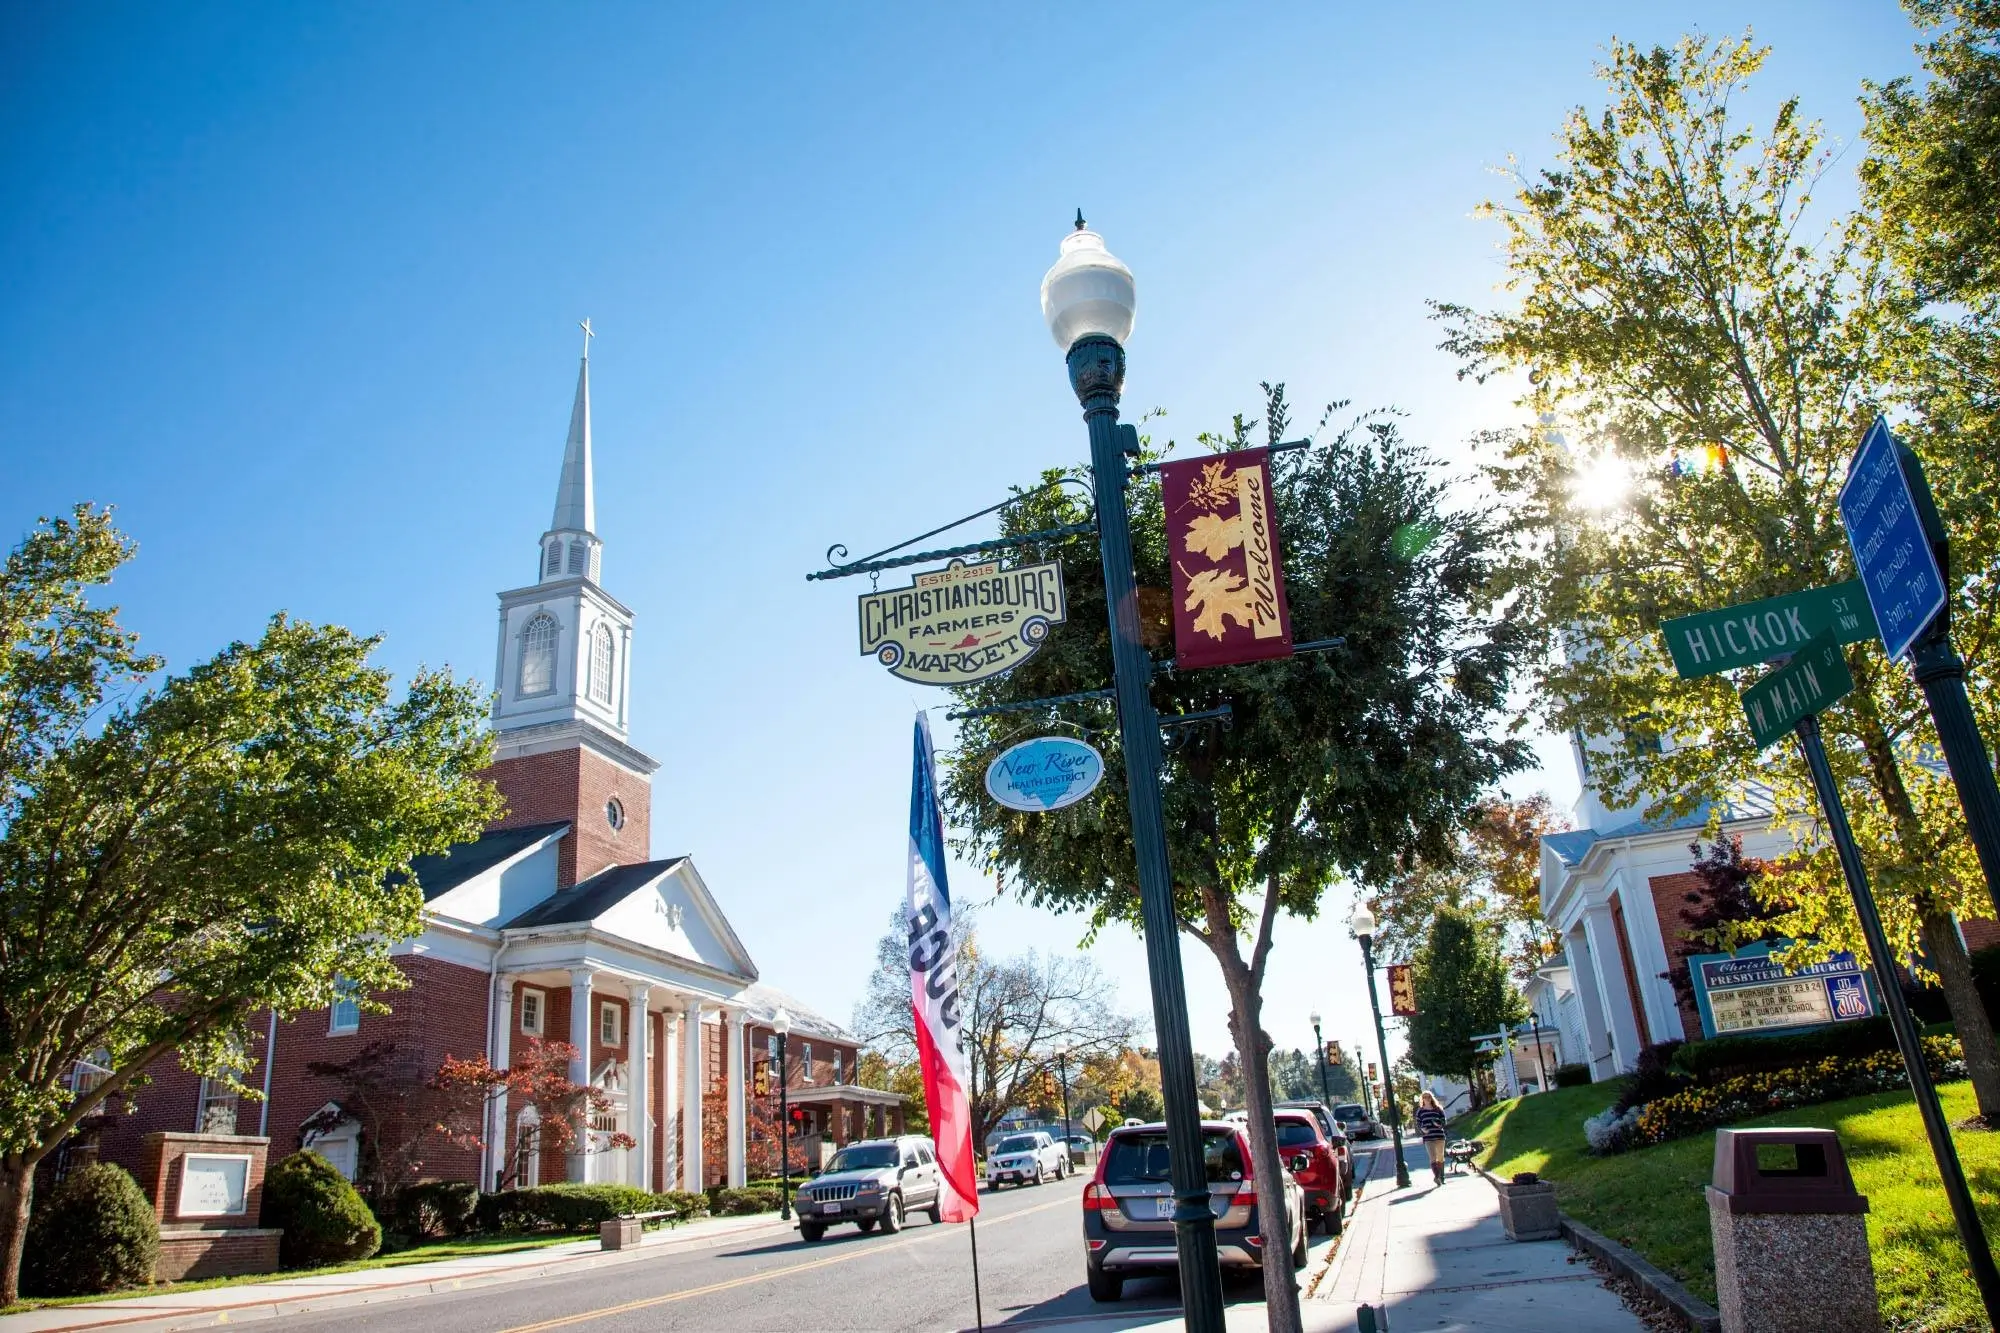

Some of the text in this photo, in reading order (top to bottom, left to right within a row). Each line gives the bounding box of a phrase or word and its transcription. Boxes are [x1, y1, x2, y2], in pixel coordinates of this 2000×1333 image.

[1847, 447, 1896, 533] Christiansburg
[1857, 486, 1909, 572] Farmers Market
[1248, 477, 1276, 626] Welcome
[1874, 536, 1914, 595] Thursdays
[962, 566, 994, 579] 2015
[866, 569, 1057, 645] CHRISTIANSBURG
[909, 610, 1020, 639] FARMERS'
[1685, 598, 1859, 664] HICKOK ST NW
[904, 634, 1022, 673] MARKET
[1769, 664, 1822, 723] MAIN
[1823, 647, 1835, 667] ST
[998, 752, 1091, 778] New River
[1007, 771, 1086, 790] HEALTH DISTRICT
[1710, 960, 1854, 986] PRESBYTERIN CHURCH
[1737, 988, 1775, 999] WORKSHOP
[1794, 984, 1804, 992] 23
[1742, 999, 1759, 1008] CALL
[1761, 997, 1775, 1006] FOR
[1740, 1009, 1752, 1018] AM
[1786, 1003, 1815, 1013] SCHOOL
